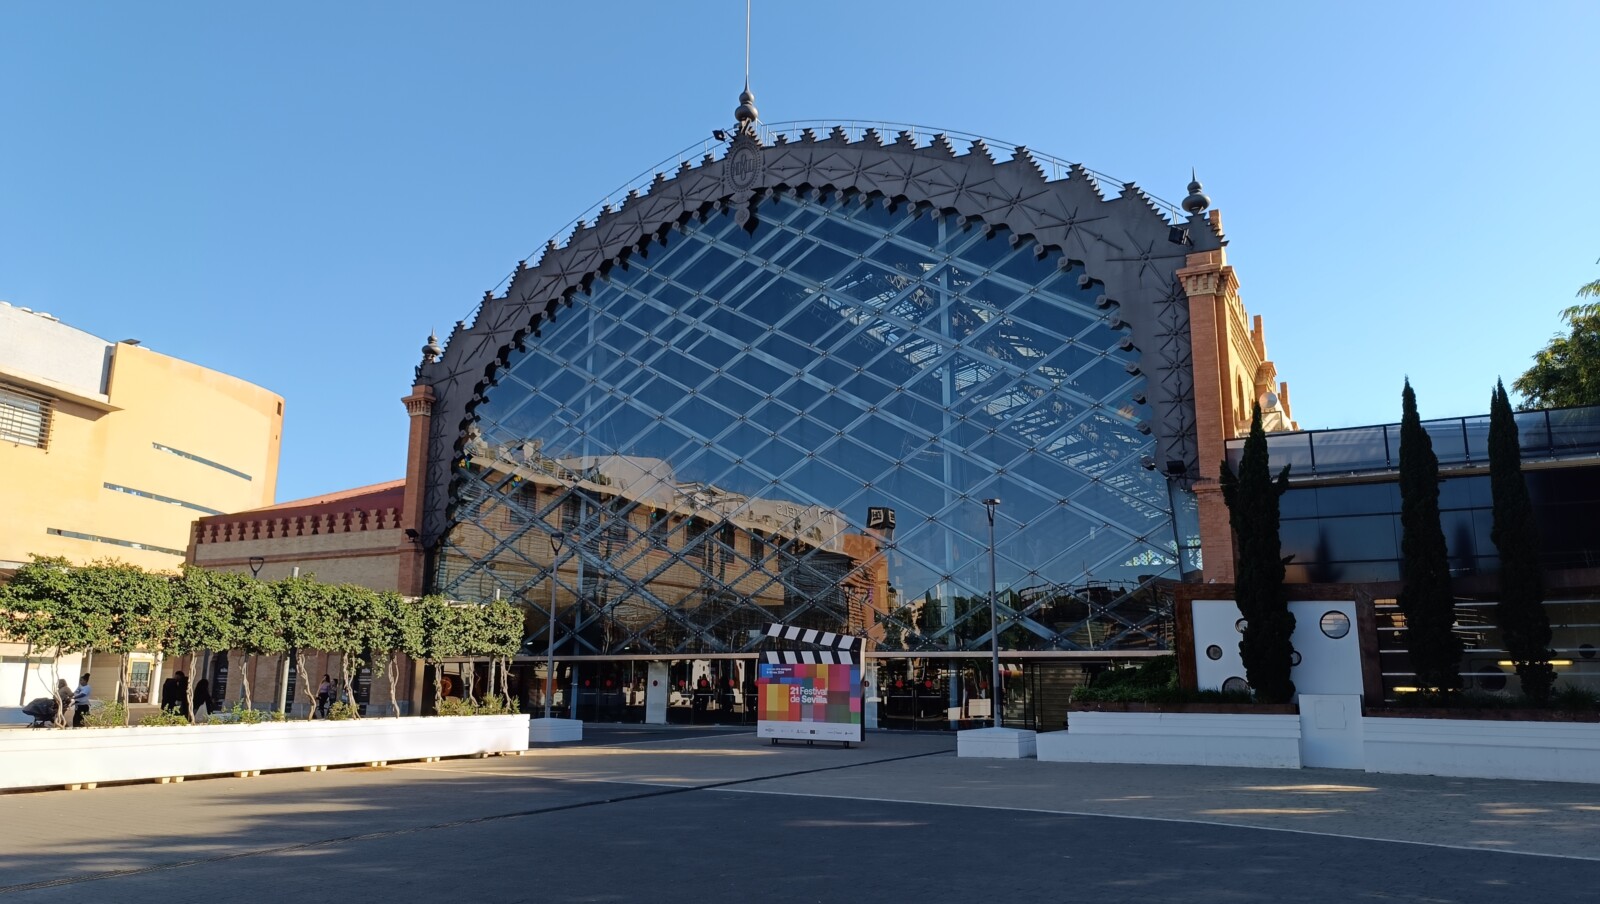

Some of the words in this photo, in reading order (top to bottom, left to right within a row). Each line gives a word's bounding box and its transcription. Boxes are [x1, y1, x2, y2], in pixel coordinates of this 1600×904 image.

[790, 686, 799, 695] 21
[800, 686, 828, 696] Festival
[790, 695, 800, 703] de
[801, 695, 828, 704] Sevilla
